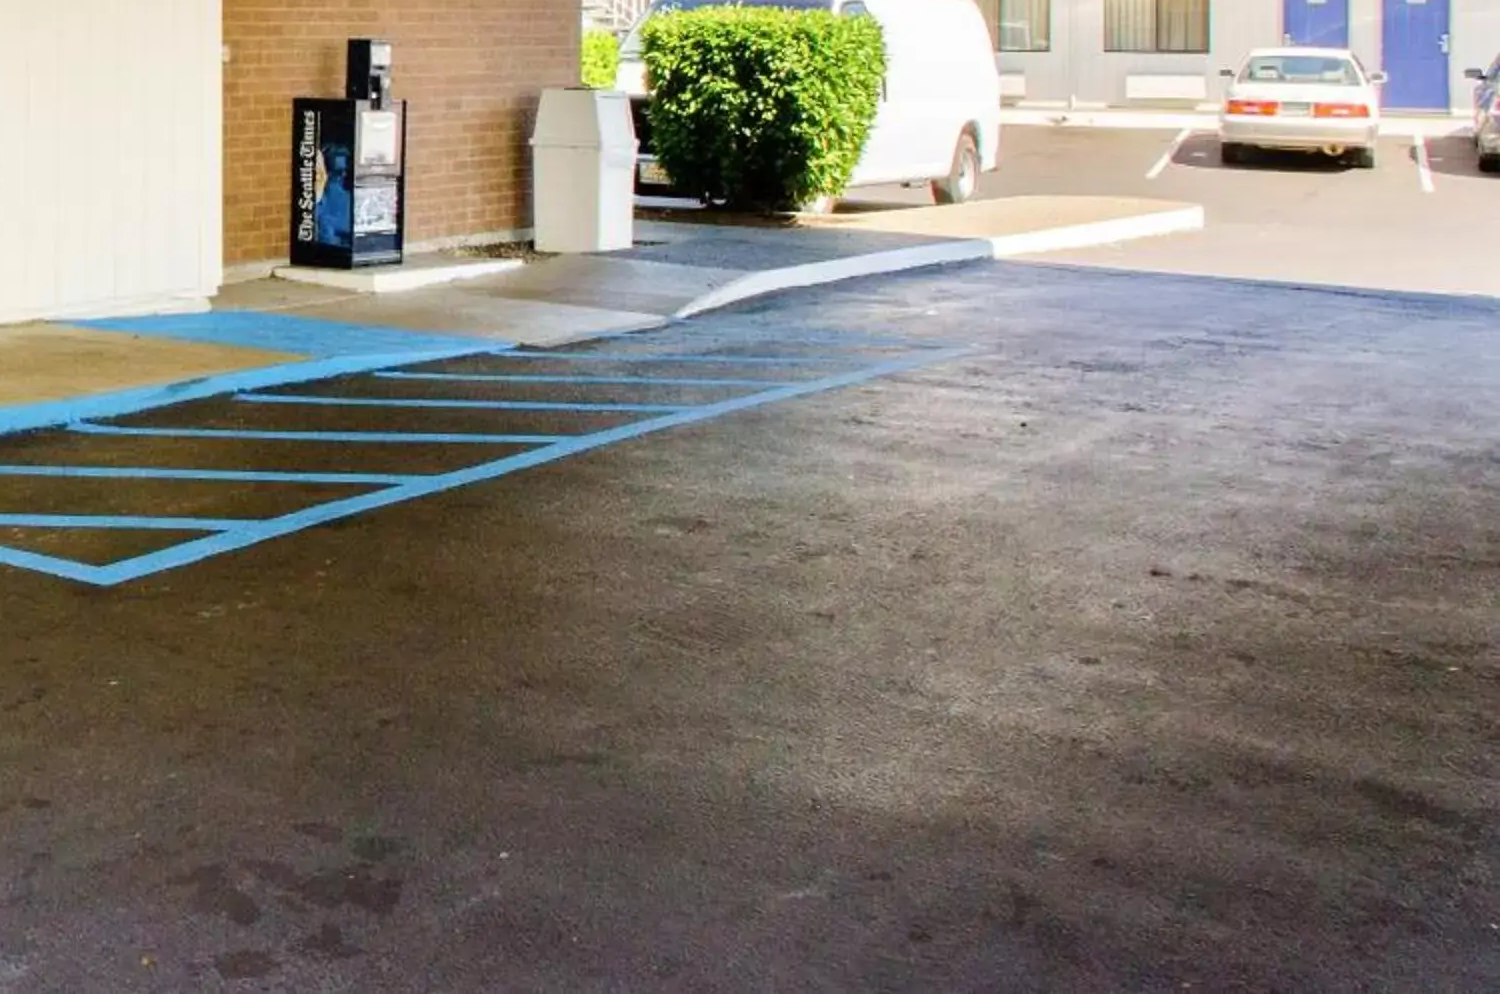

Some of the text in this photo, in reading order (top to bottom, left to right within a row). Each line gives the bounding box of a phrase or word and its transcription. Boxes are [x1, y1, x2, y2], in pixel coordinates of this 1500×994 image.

[298, 109, 315, 242] The Seattle Times
